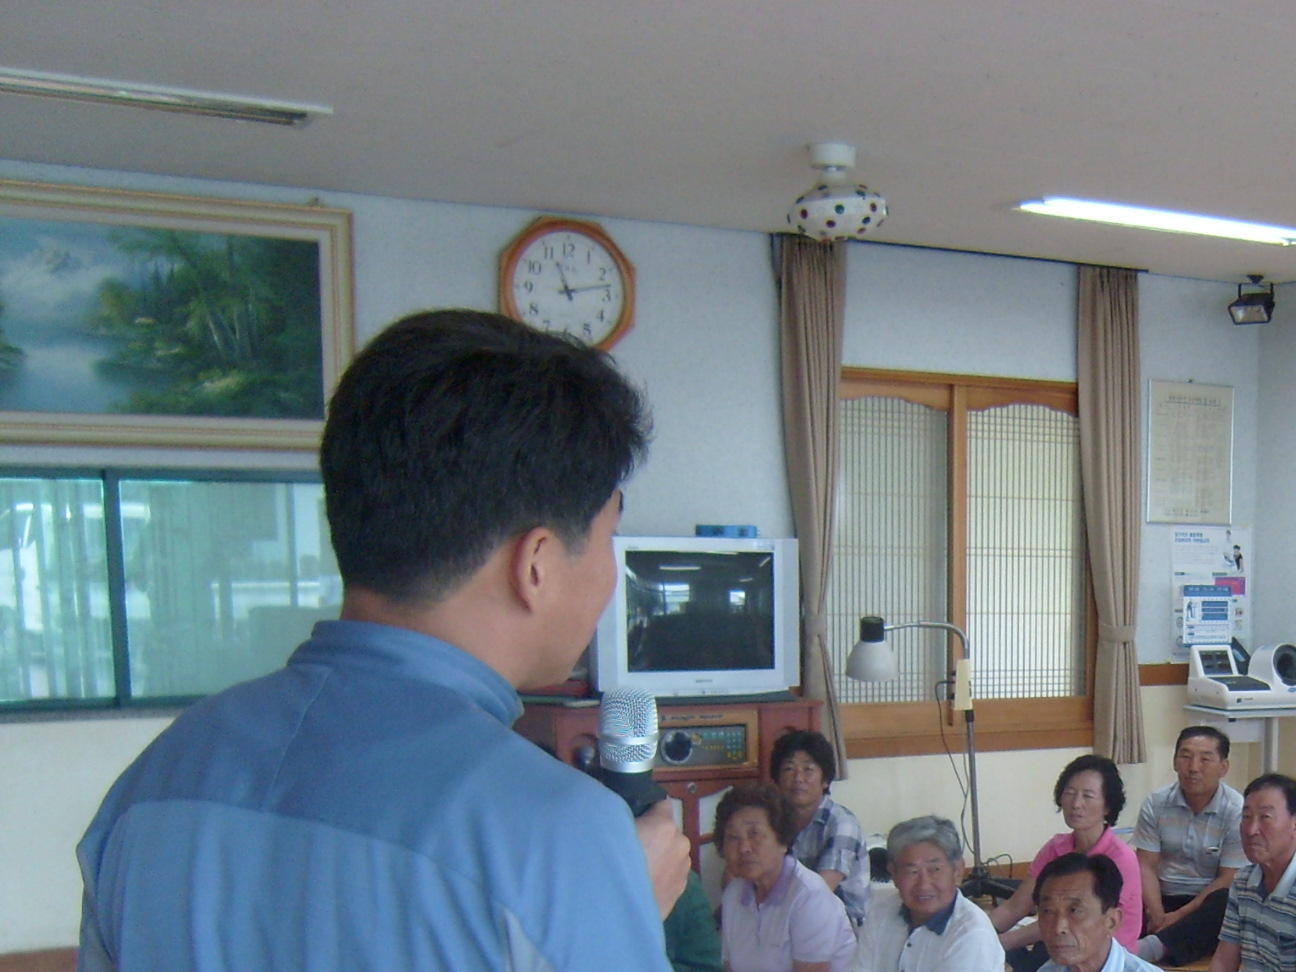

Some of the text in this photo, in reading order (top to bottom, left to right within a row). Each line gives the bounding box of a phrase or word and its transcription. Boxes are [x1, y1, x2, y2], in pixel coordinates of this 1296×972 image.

[544, 246, 554, 260] 11
[562, 243, 575, 258] 12
[528, 260, 542, 275] 10
[599, 267, 606, 281] 2
[524, 281, 533, 293] 9
[602, 289, 611, 302] 3
[529, 302, 539, 315] 8
[596, 309, 605, 322] 4
[583, 323, 591, 336] 5
